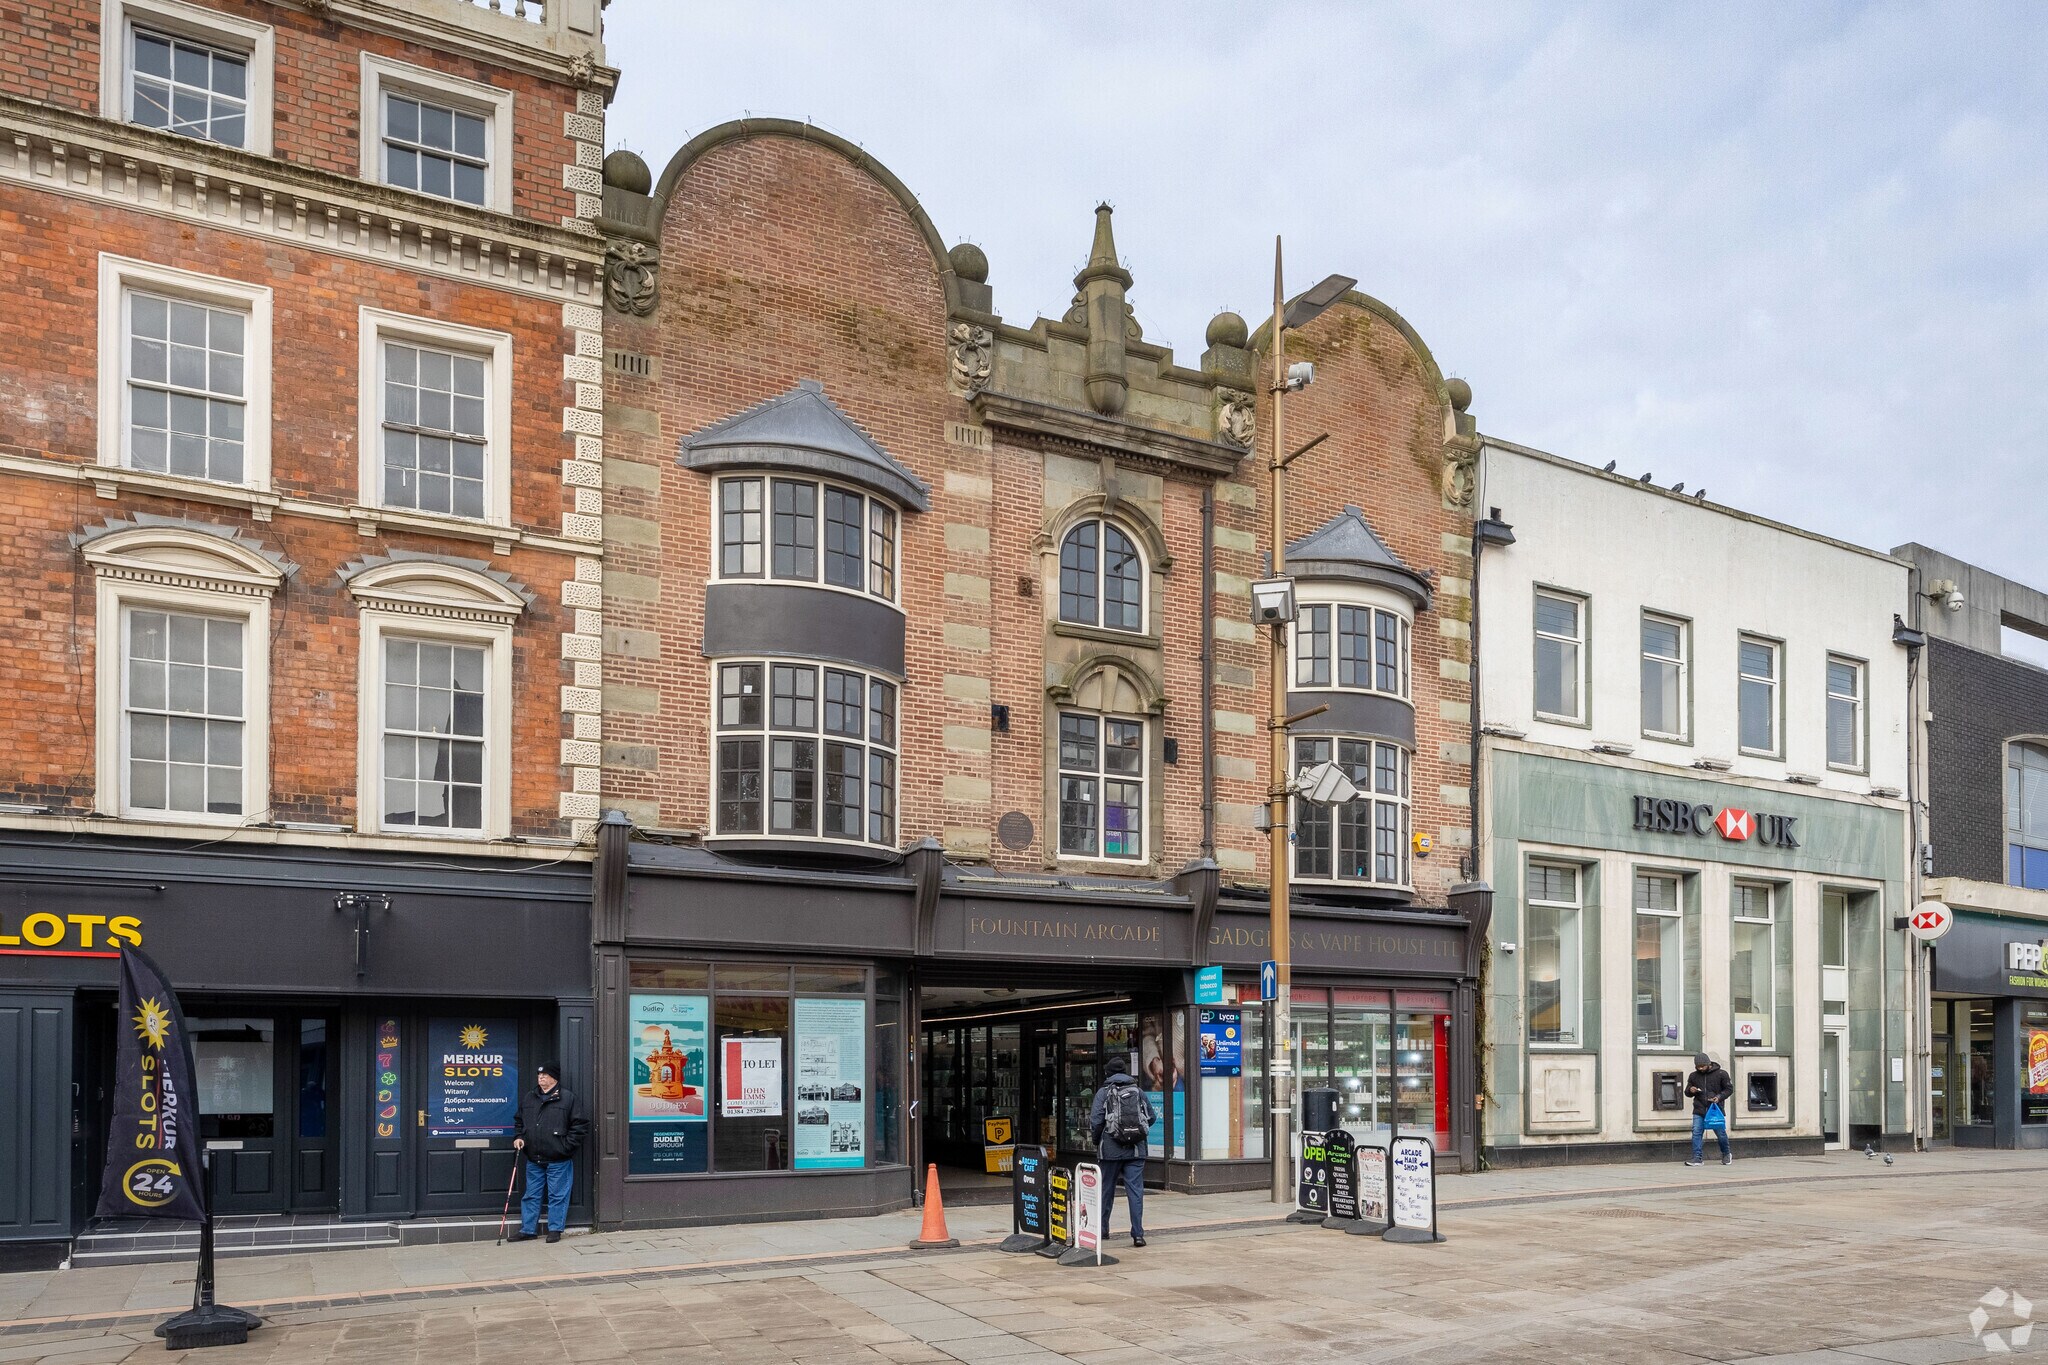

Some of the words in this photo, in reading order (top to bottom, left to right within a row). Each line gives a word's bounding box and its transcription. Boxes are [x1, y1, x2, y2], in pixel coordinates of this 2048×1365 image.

[1633, 795, 1713, 838] HSBC
[1755, 813, 1801, 848] UK
[970, 917, 1078, 938] FOUNTAIN
[1084, 924, 1160, 942] ARCADE
[1208, 927, 1296, 950] GADGS
[1301, 933, 1313, 950] &
[1320, 932, 1362, 952] VAPE
[1369, 936, 1427, 956] HOUSE
[2008, 942, 2042, 971] PEP
[1200, 973, 1216, 981] Heated
[1200, 982, 1217, 990] tobacco
[642, 1004, 664, 1013] Dudley
[1219, 1013, 1235, 1022] Lyca
[443, 1054, 504, 1064] MERKUR
[742, 1060, 756, 1069] TO
[758, 1060, 777, 1069] LET
[444, 1067, 503, 1077] SLOTS
[136, 1055, 157, 1150] SLOTS
[1400, 1148, 1422, 1157] ARCADE
[1022, 1157, 1038, 1165] ARCADE
[1404, 1156, 1418, 1164] HAIR
[1403, 1164, 1418, 1172] SHOP
[132, 1173, 174, 1194] 24
[1024, 1175, 1035, 1184] OPEN
